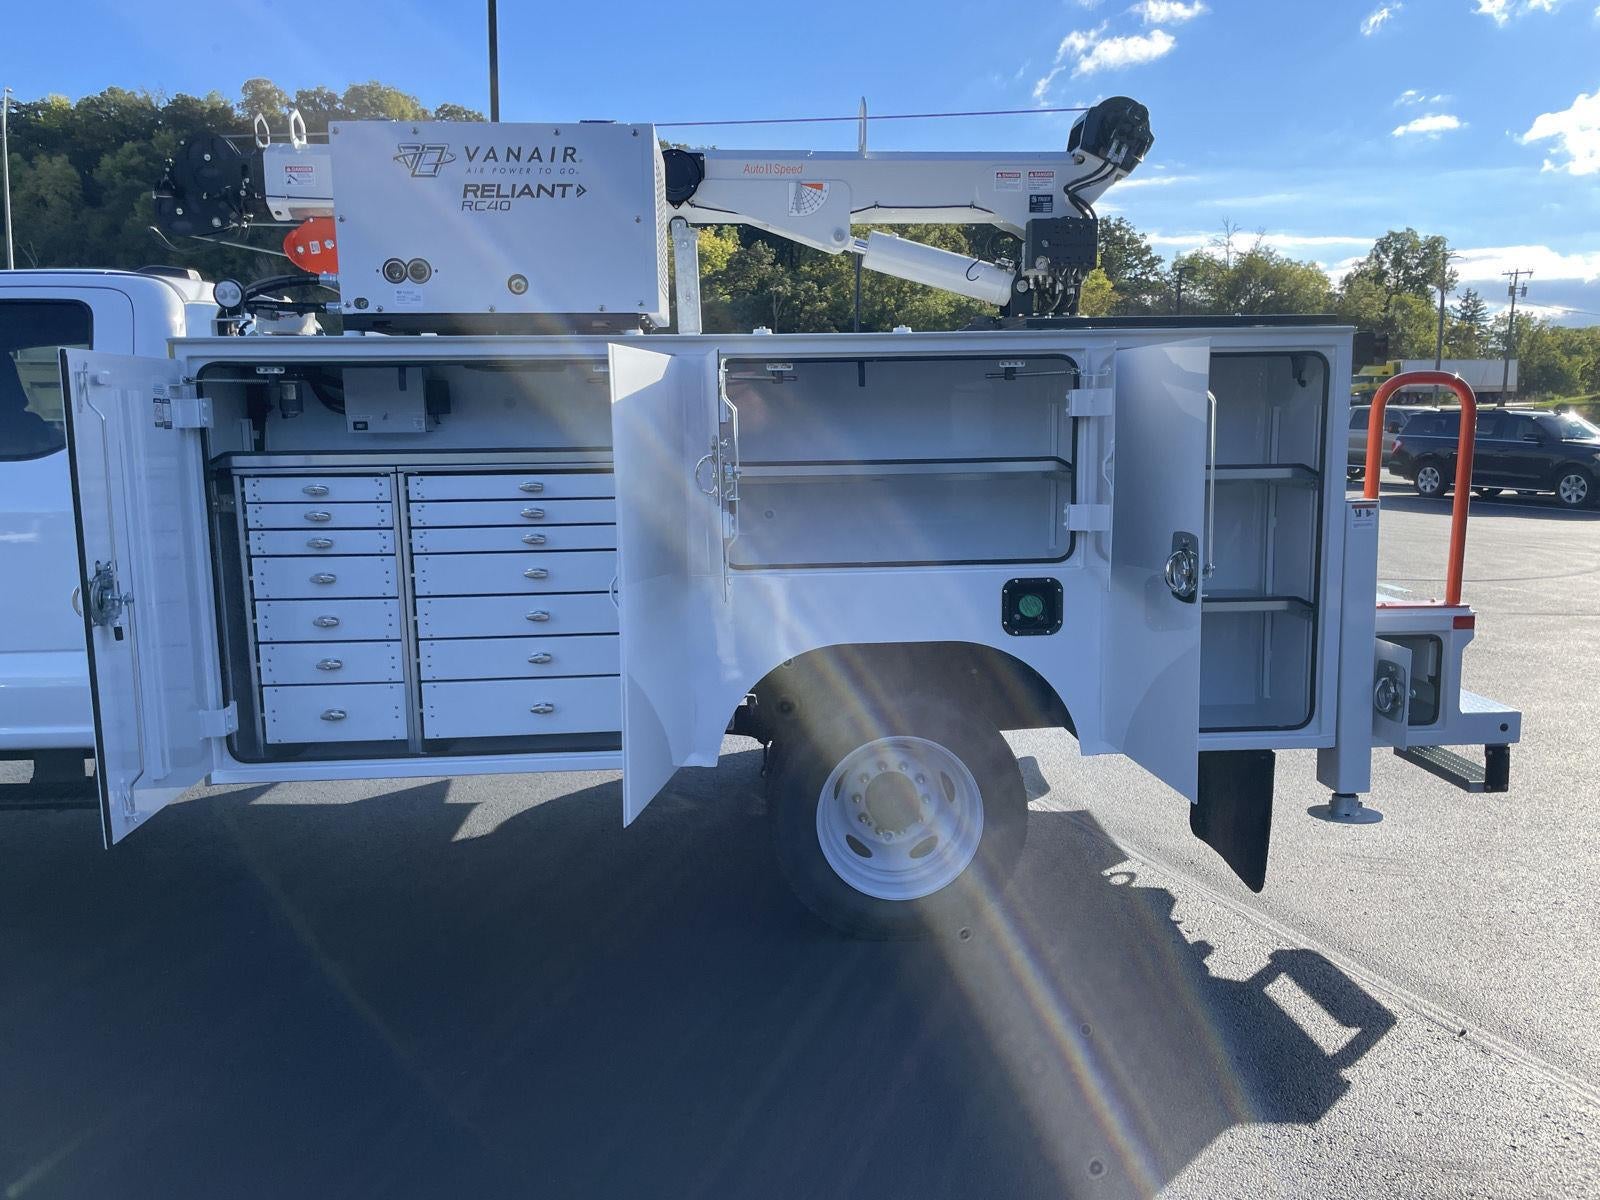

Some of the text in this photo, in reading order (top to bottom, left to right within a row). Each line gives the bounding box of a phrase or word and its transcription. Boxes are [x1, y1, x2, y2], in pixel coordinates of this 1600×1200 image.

[465, 167, 484, 175] AIR
[491, 167, 532, 175] POWER
[539, 167, 551, 175] TO
[743, 163, 764, 174] Auto
[774, 163, 803, 176] Speed
[462, 183, 573, 199] RELIANT
[461, 200, 511, 212] RC40
